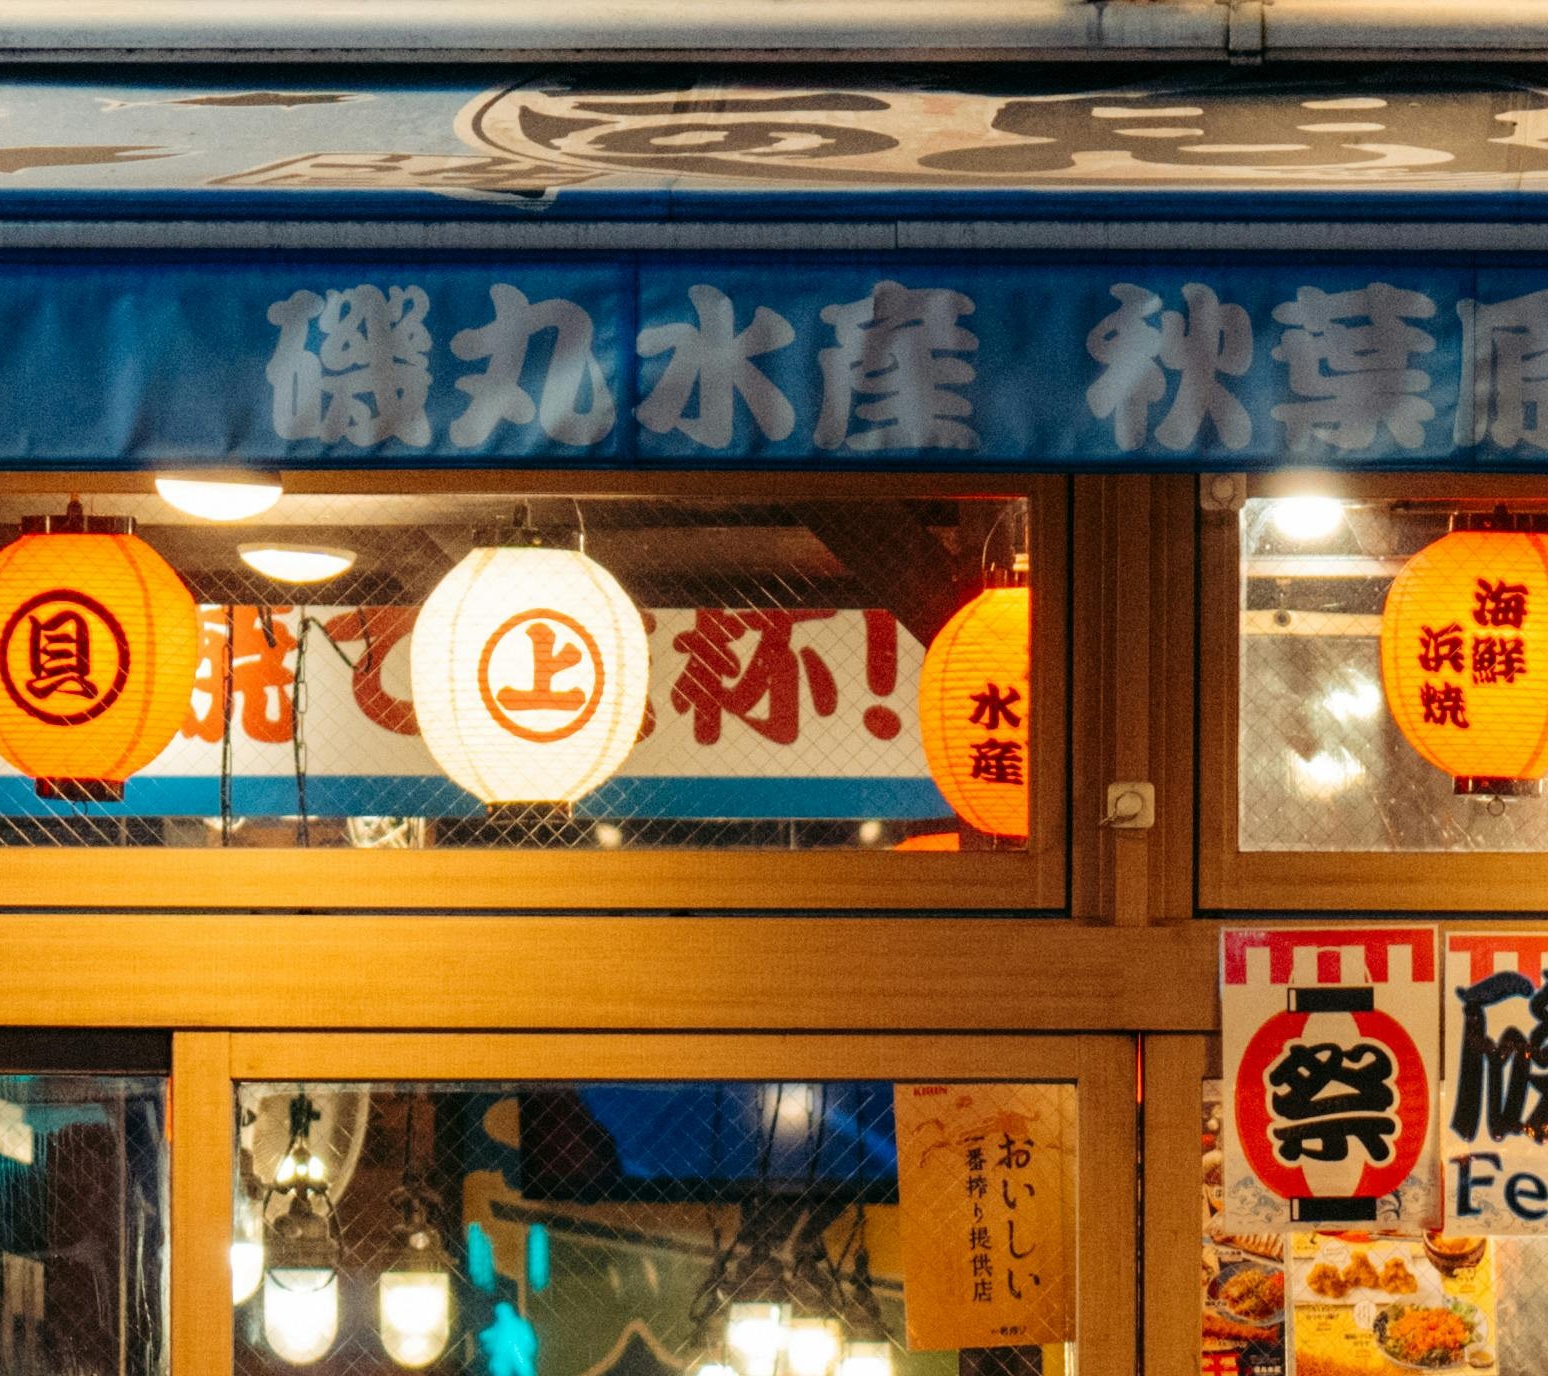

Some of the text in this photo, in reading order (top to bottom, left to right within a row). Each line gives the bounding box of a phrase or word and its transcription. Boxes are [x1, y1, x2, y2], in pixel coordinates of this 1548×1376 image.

[267, 281, 981, 453] 磯丸水産
[24, 614, 107, 701] 貝
[498, 623, 585, 713] 上
[1418, 625, 1471, 731] 浜焼
[1472, 577, 1530, 685] 海鮮
[968, 683, 1025, 786] 水産
[1266, 1042, 1401, 1163] 祭
[964, 1136, 994, 1302] 一番搾り提供店
[998, 1133, 1040, 1300] おいしい
